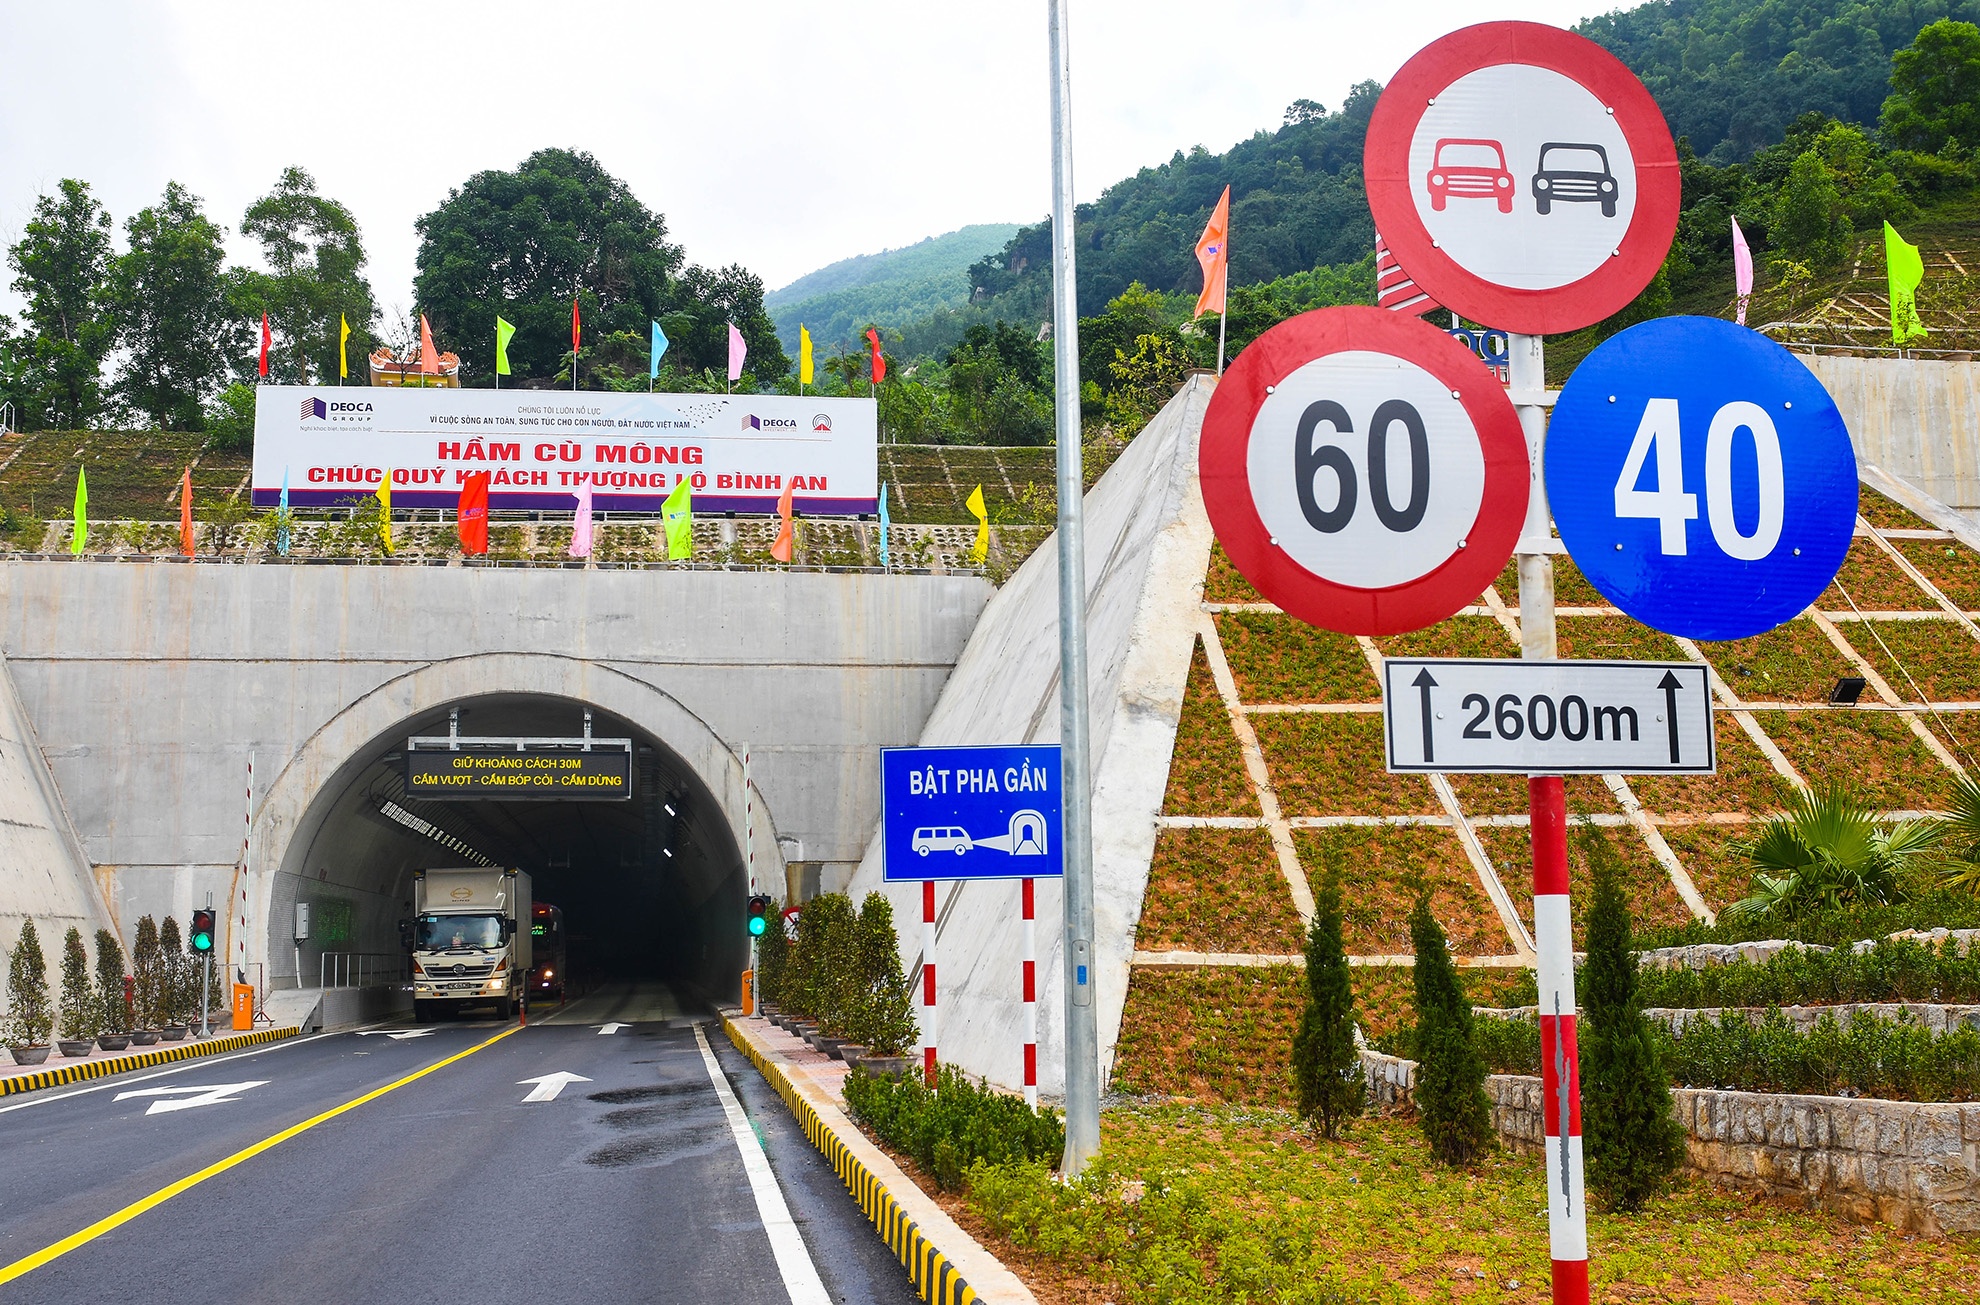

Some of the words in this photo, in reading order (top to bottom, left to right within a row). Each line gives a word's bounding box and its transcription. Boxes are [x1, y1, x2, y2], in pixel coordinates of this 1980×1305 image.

[331, 402, 374, 412] DEOCA
[517, 405, 542, 414] CHÚNG
[439, 416, 459, 426] CUỘC
[483, 416, 493, 425] AN
[519, 417, 539, 426] SUNG
[541, 417, 555, 427] TÚC
[557, 418, 572, 427] CHO
[574, 418, 589, 427] CON
[674, 421, 691, 429] NAM
[763, 419, 797, 427] DEOCA
[438, 436, 520, 461] HẦM
[535, 440, 582, 462] CÙ
[596, 443, 703, 464] MÔNG
[1295, 399, 1430, 534] 60
[308, 465, 382, 483] CHÚC
[393, 466, 446, 485] QUÝ
[456, 467, 548, 486] KÁCH
[557, 471, 666, 490] THƯỢNG
[717, 472, 781, 489] BÌNH
[792, 475, 827, 490] AN
[1614, 398, 1784, 561] 40
[1461, 693, 1640, 741] 2600m
[452, 755, 474, 768] GIỮ
[475, 755, 523, 768] KHOẢNG
[525, 756, 557, 768] CÁCH
[559, 758, 582, 769] 30M
[412, 772, 438, 785] CẤM
[440, 775, 472, 787] VƯỢT
[480, 773, 506, 785] CẤM
[508, 773, 531, 786] BÓP
[533, 773, 553, 786] CÒI
[561, 773, 586, 786] CẤM
[588, 773, 622, 786] DỪNG
[909, 764, 950, 799] BẬT
[957, 768, 1000, 794] PHA
[1004, 757, 1047, 793] GẦN
